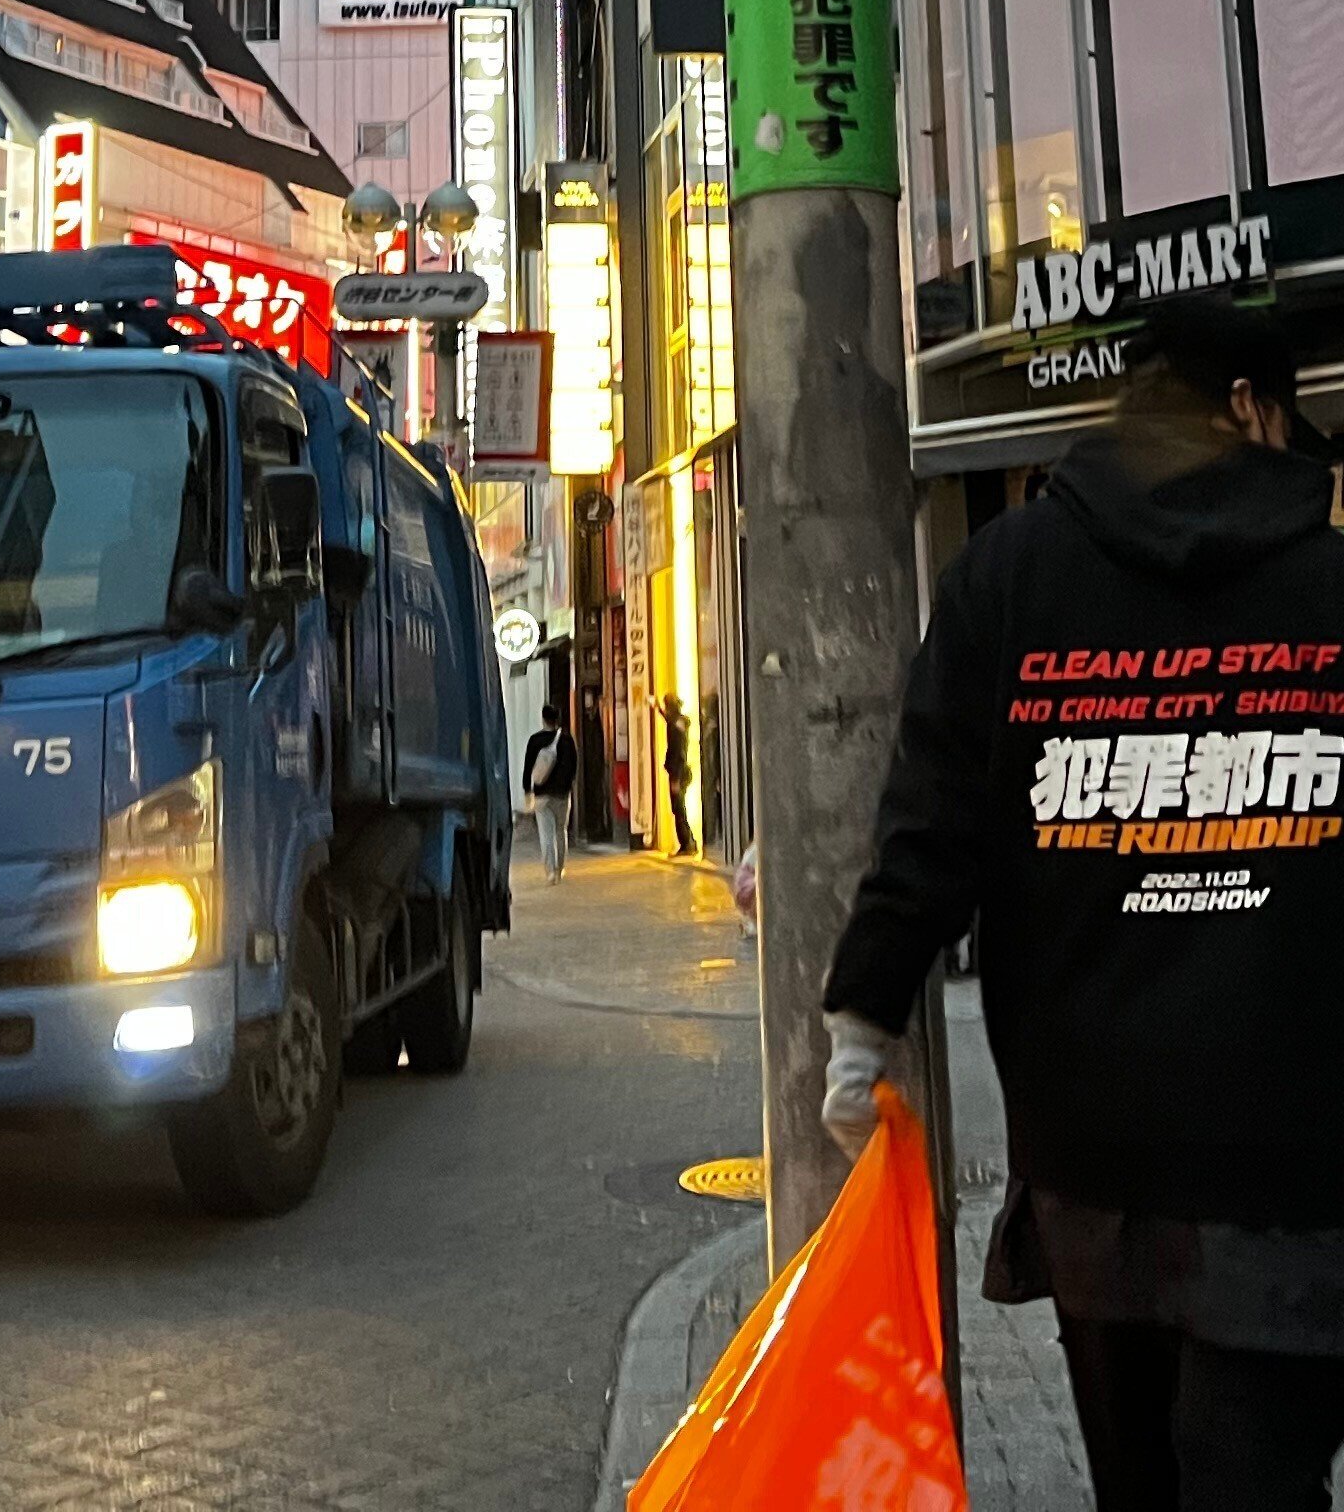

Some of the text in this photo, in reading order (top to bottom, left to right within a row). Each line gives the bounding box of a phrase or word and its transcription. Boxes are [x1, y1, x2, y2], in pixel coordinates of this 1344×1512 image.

[1012, 214, 1271, 332] ABC-MART
[1028, 339, 1131, 389] GRAN
[1019, 643, 1342, 682] CLEAN UP STAFF
[1008, 698, 1052, 723] NO
[1059, 695, 1151, 723] CRIME
[1155, 692, 1224, 719] CITY
[13, 737, 72, 777] 75
[1032, 816, 1343, 855] THE ROUNDUP
[1122, 886, 1271, 913] ROADSHOW
